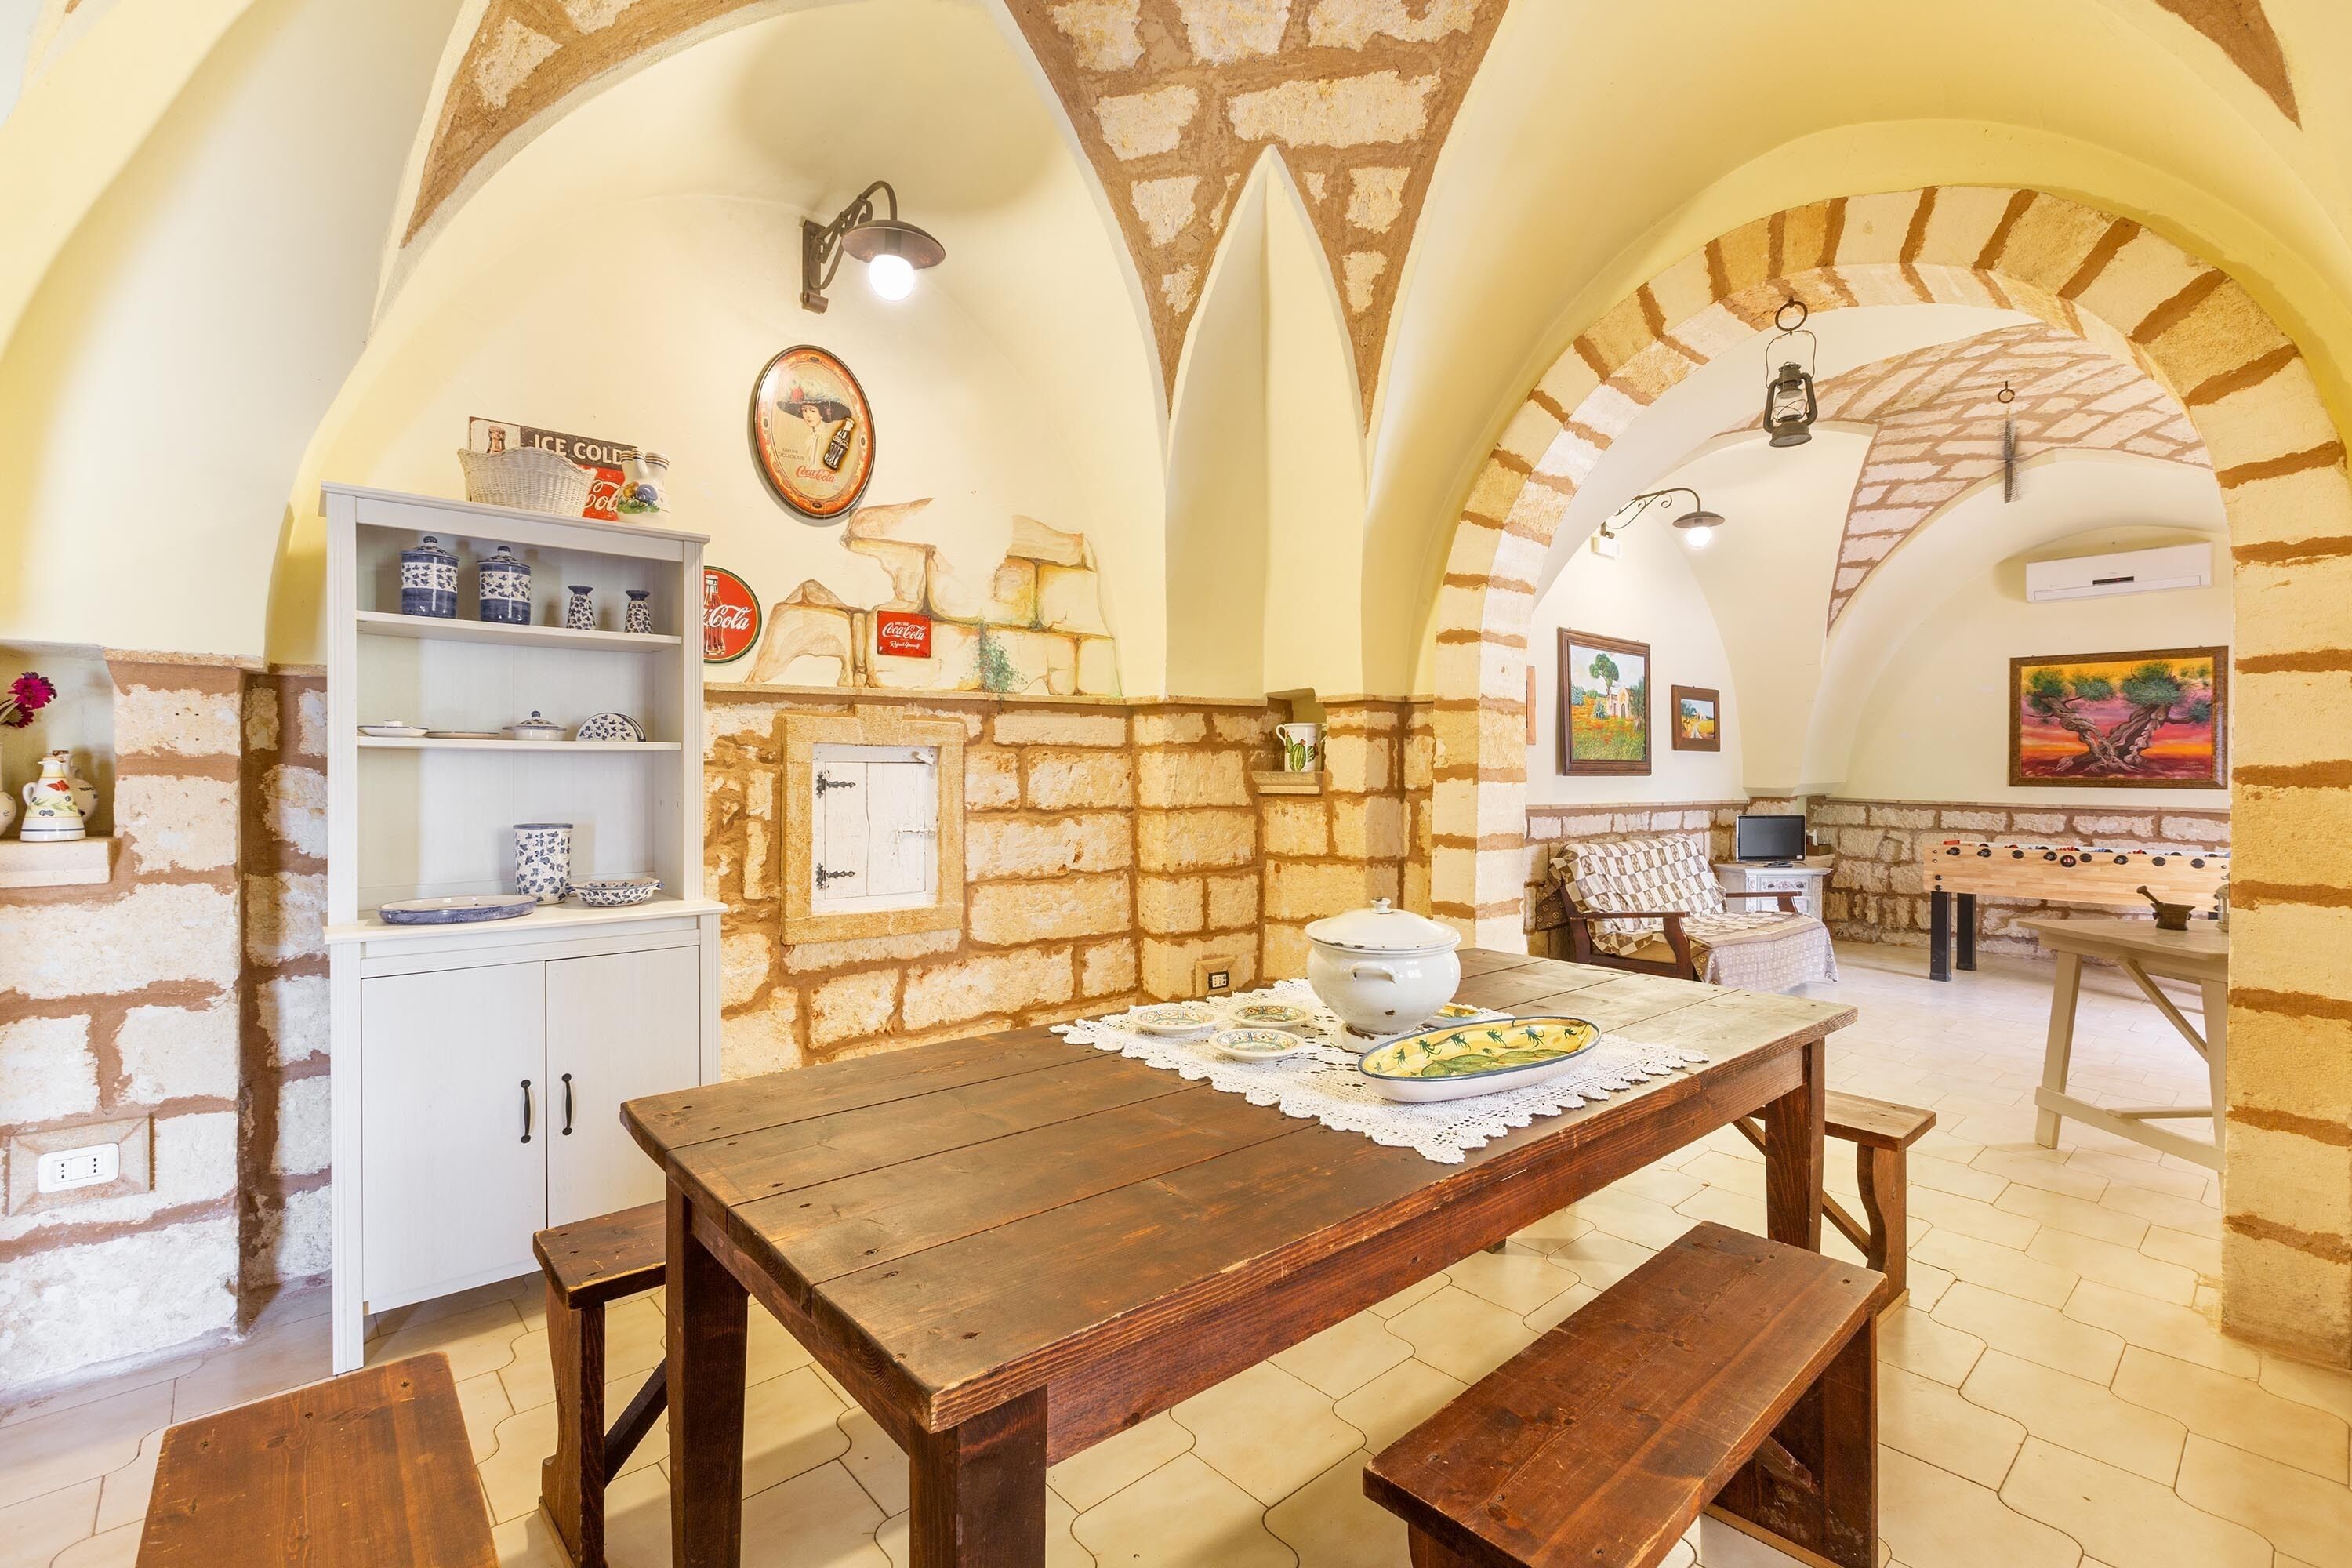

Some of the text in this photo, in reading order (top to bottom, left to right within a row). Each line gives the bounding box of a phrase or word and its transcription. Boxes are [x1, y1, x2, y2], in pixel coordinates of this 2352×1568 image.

[535, 434, 622, 466] ICE COLD
[882, 622, 927, 641] Coca-Cola
